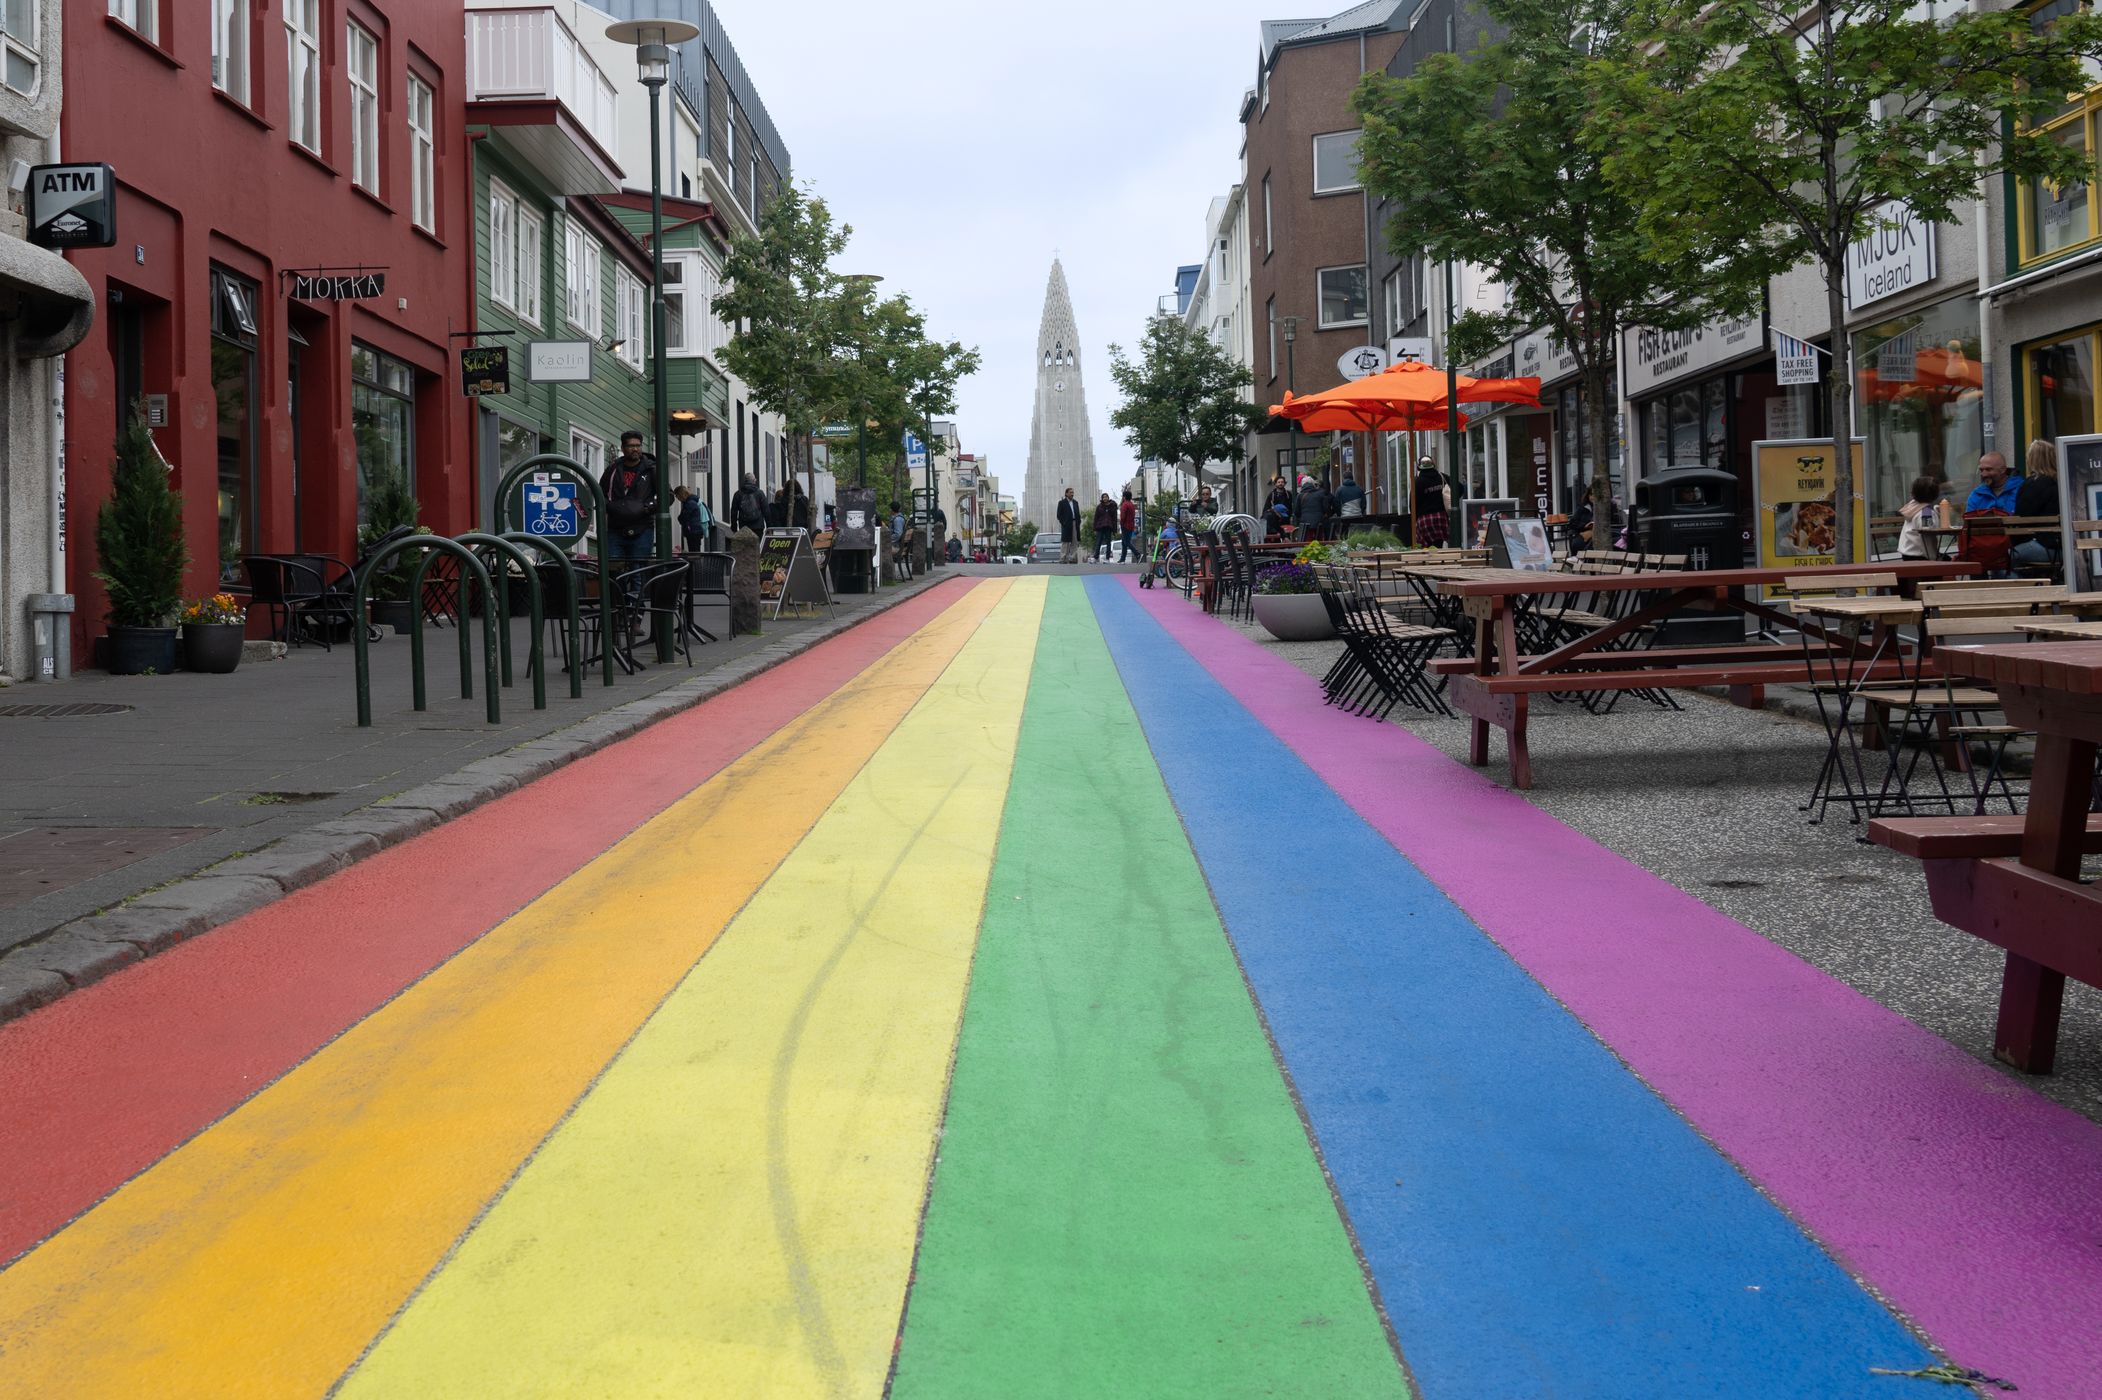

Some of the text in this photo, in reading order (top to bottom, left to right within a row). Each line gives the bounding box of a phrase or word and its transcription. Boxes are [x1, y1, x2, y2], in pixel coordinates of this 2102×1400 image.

[42, 172, 95, 193] ATM
[1857, 205, 1916, 269] MJÚK
[297, 275, 382, 303] MOKKA
[1864, 255, 1911, 300] Iceland
[1638, 328, 1660, 366] FISH
[1661, 332, 1671, 355] &
[537, 354, 585, 366] Kaolin
[1653, 352, 1688, 377] RESTAURANT
[1781, 359, 1814, 369] TAX FREE
[1781, 368, 1814, 378] SHOPPING
[541, 486, 560, 511] P
[769, 539, 792, 550] Open
